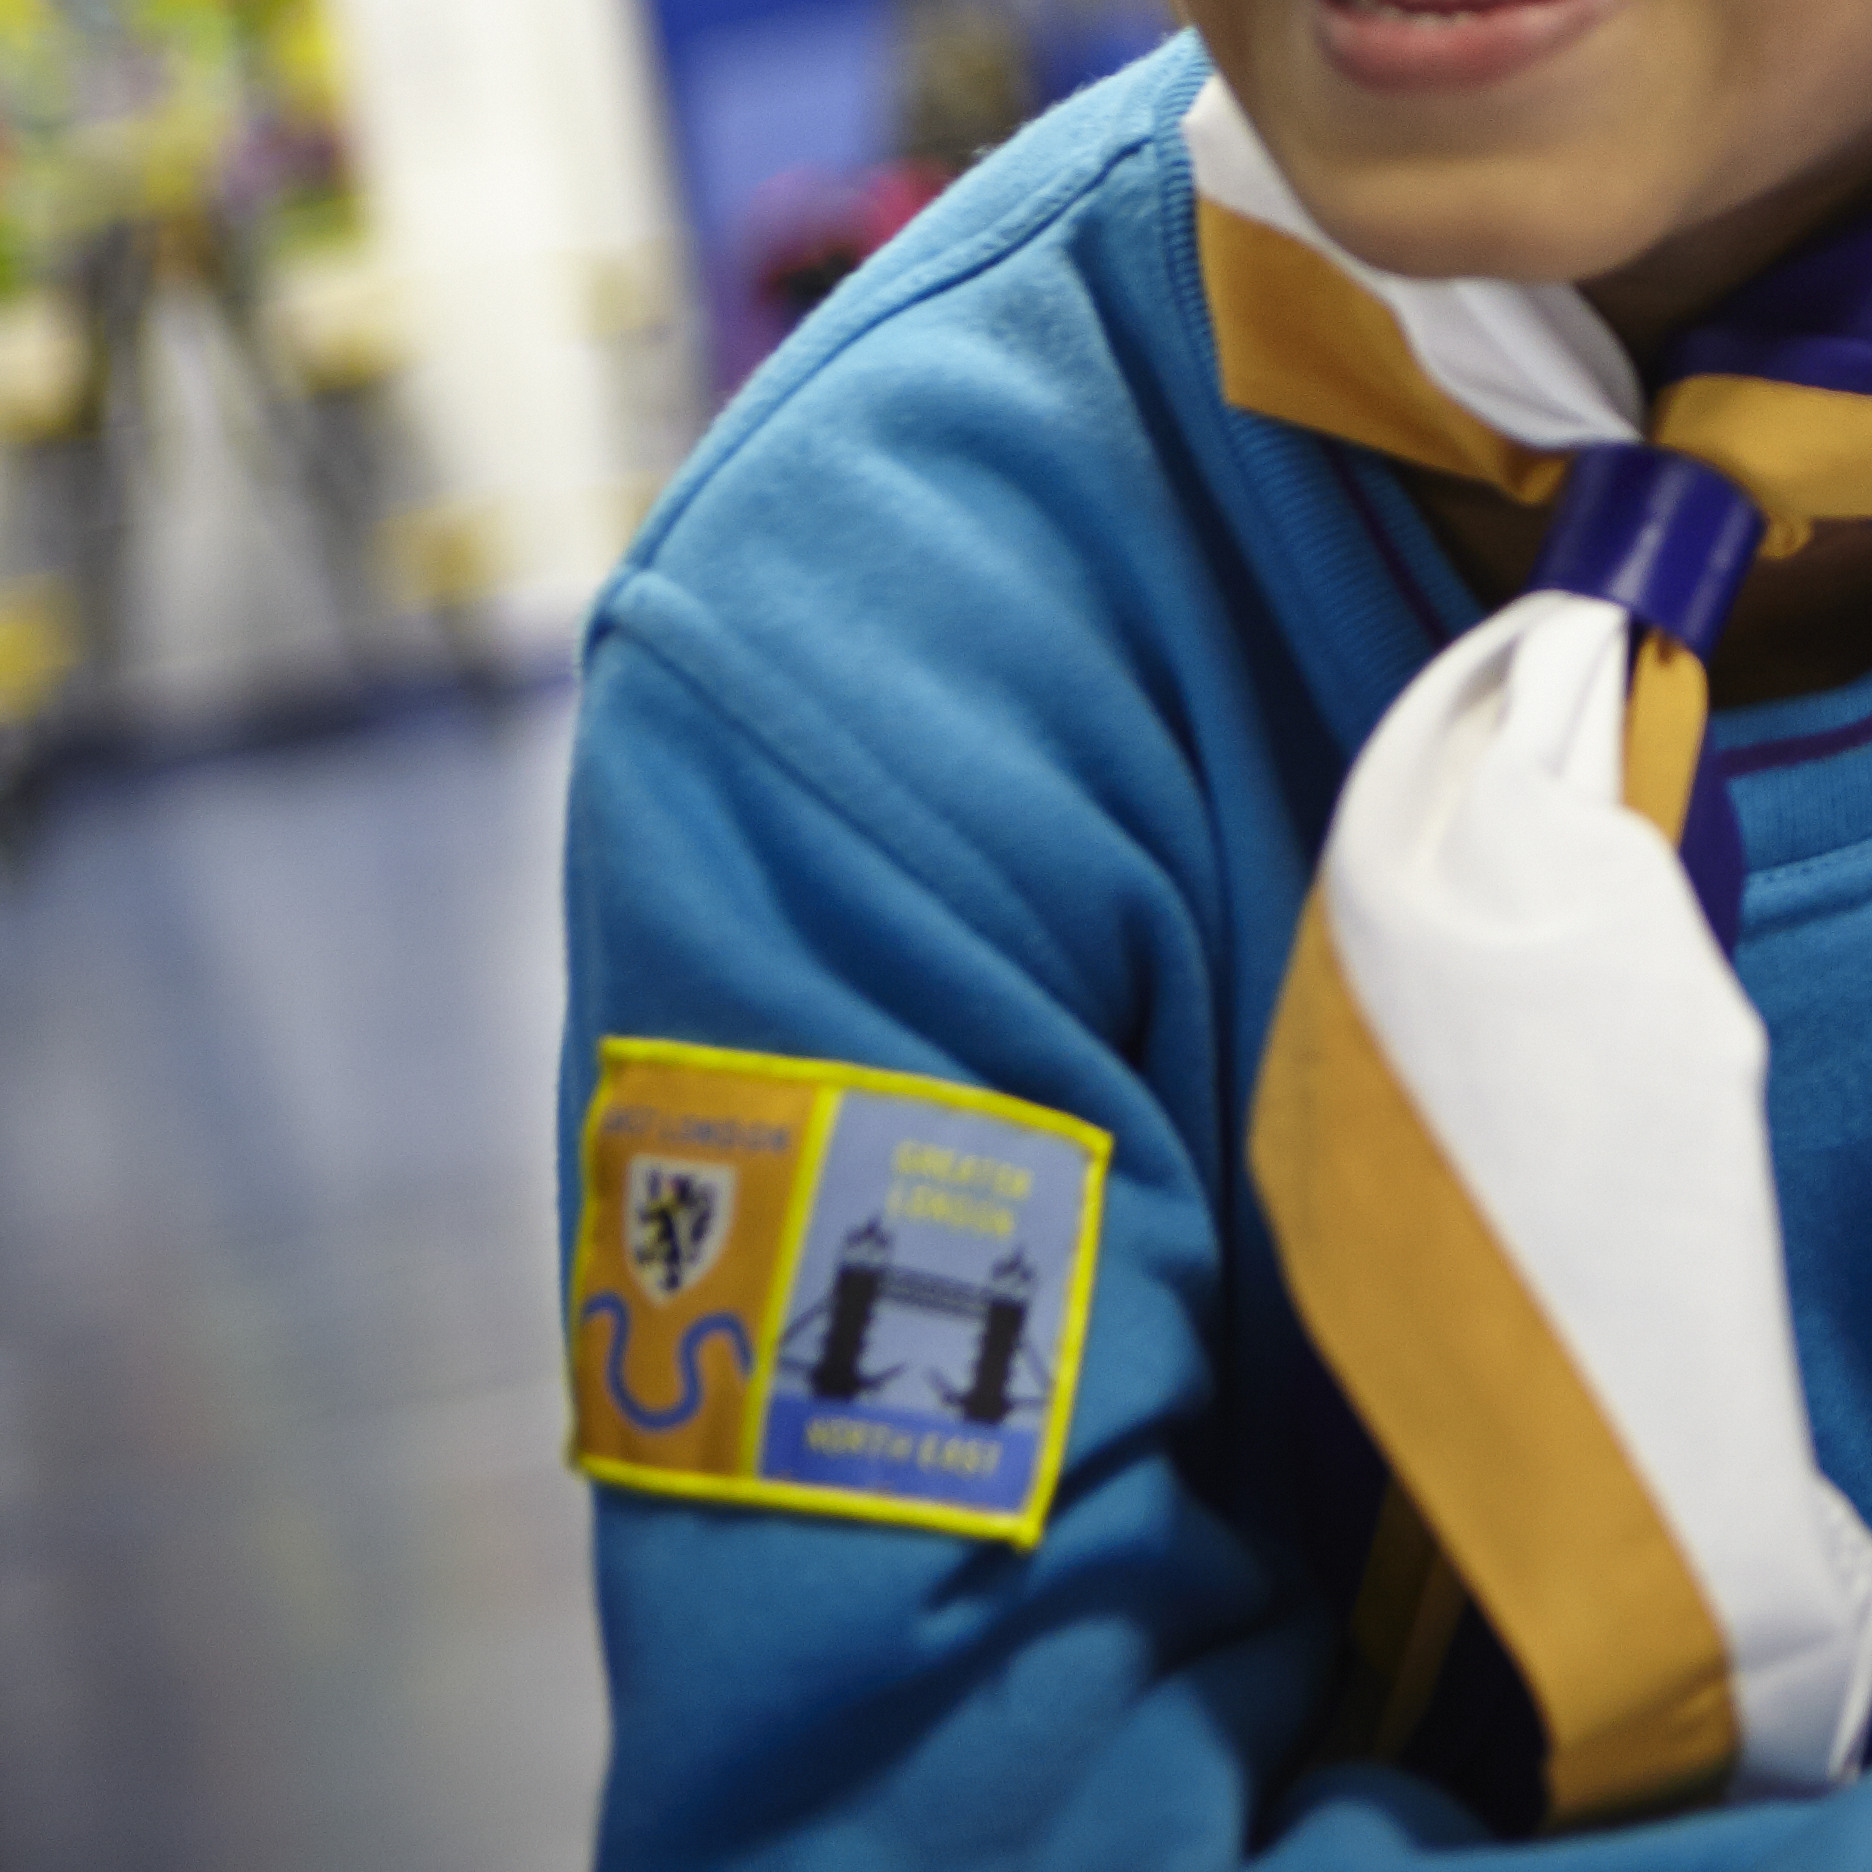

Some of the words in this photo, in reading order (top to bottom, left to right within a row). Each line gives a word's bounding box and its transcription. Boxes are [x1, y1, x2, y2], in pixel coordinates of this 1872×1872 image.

[892, 1138, 1034, 1198] GREATER
[886, 1182, 1014, 1238] LONDON
[805, 1417, 913, 1461] NORTH
[916, 1430, 1003, 1477] EAST
